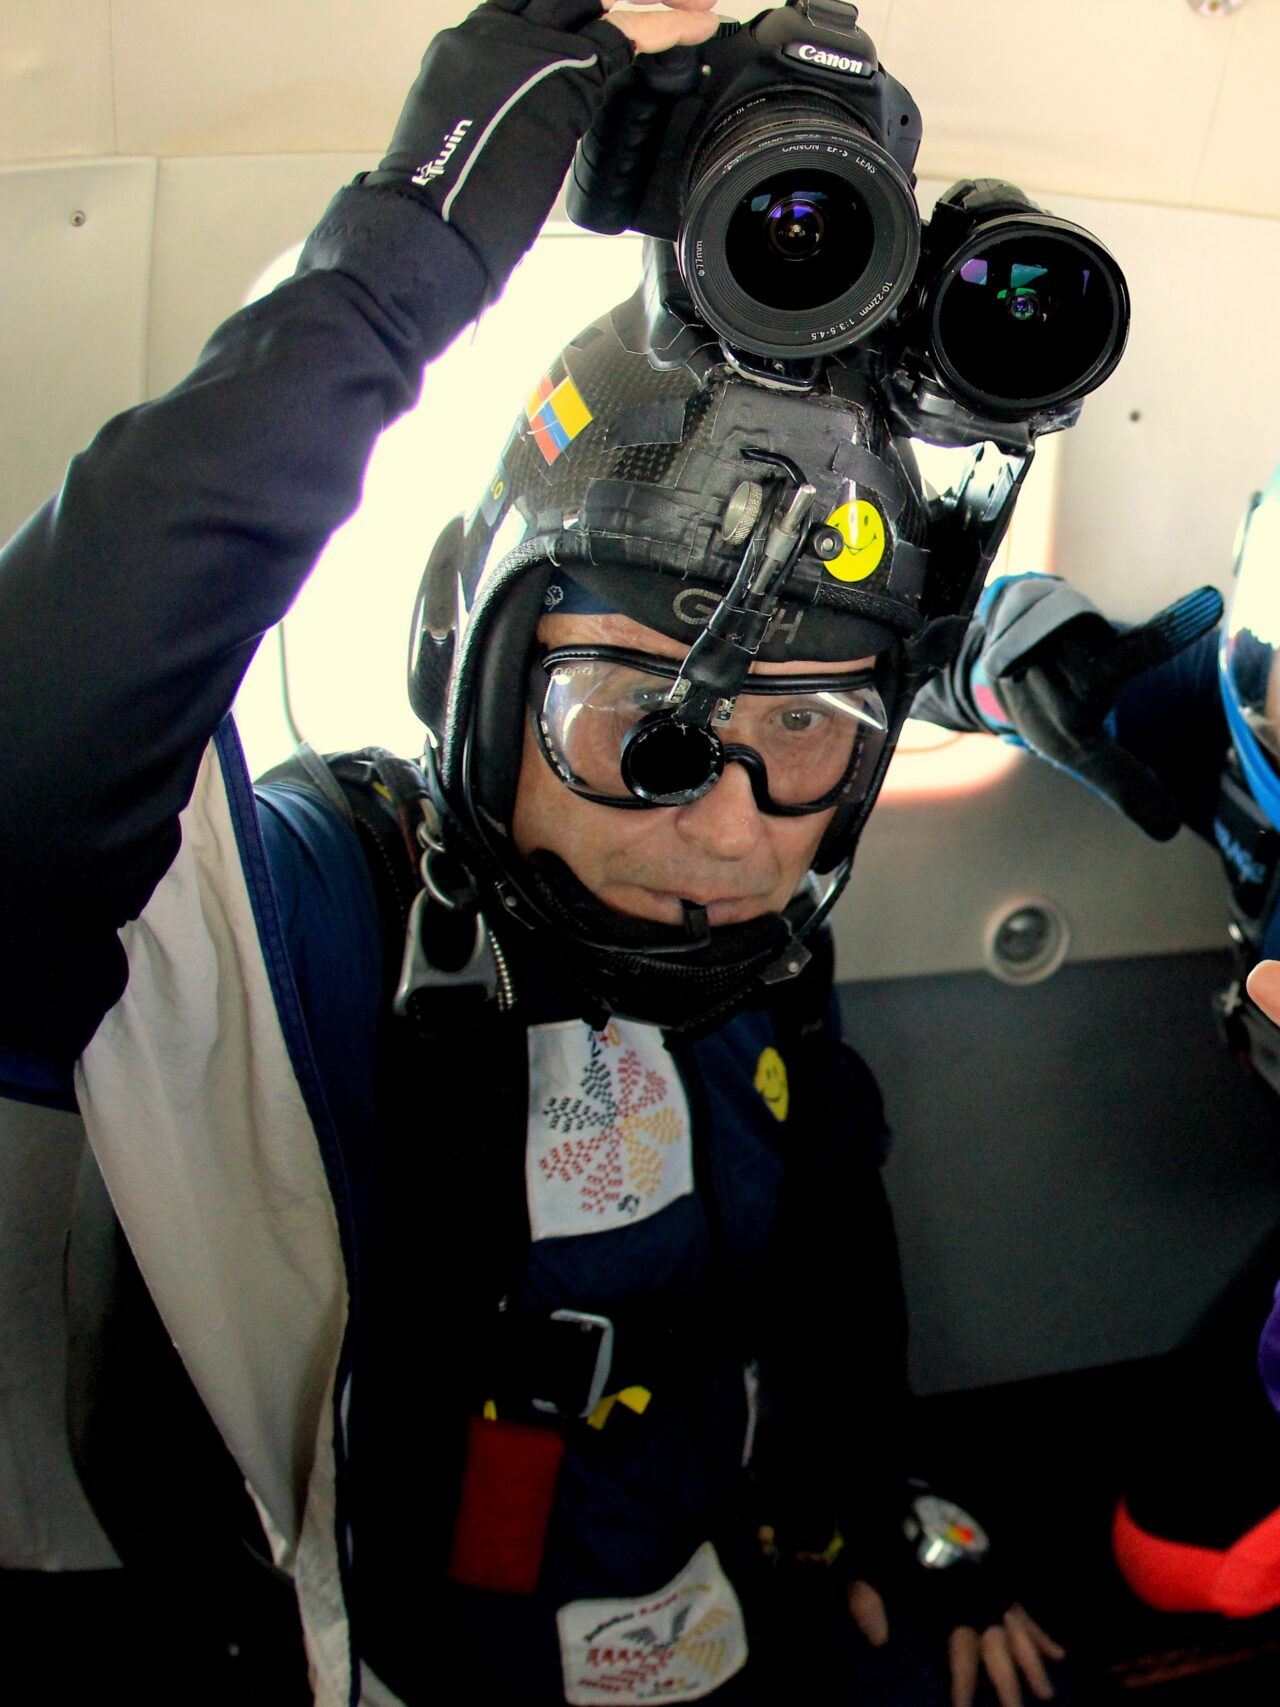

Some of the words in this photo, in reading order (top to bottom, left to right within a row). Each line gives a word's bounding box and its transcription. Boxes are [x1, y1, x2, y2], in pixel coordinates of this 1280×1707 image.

[798, 44, 863, 74] Canon
[859, 280, 893, 317] 10-22mm
[810, 318, 856, 341] 1:3.5-4.5
